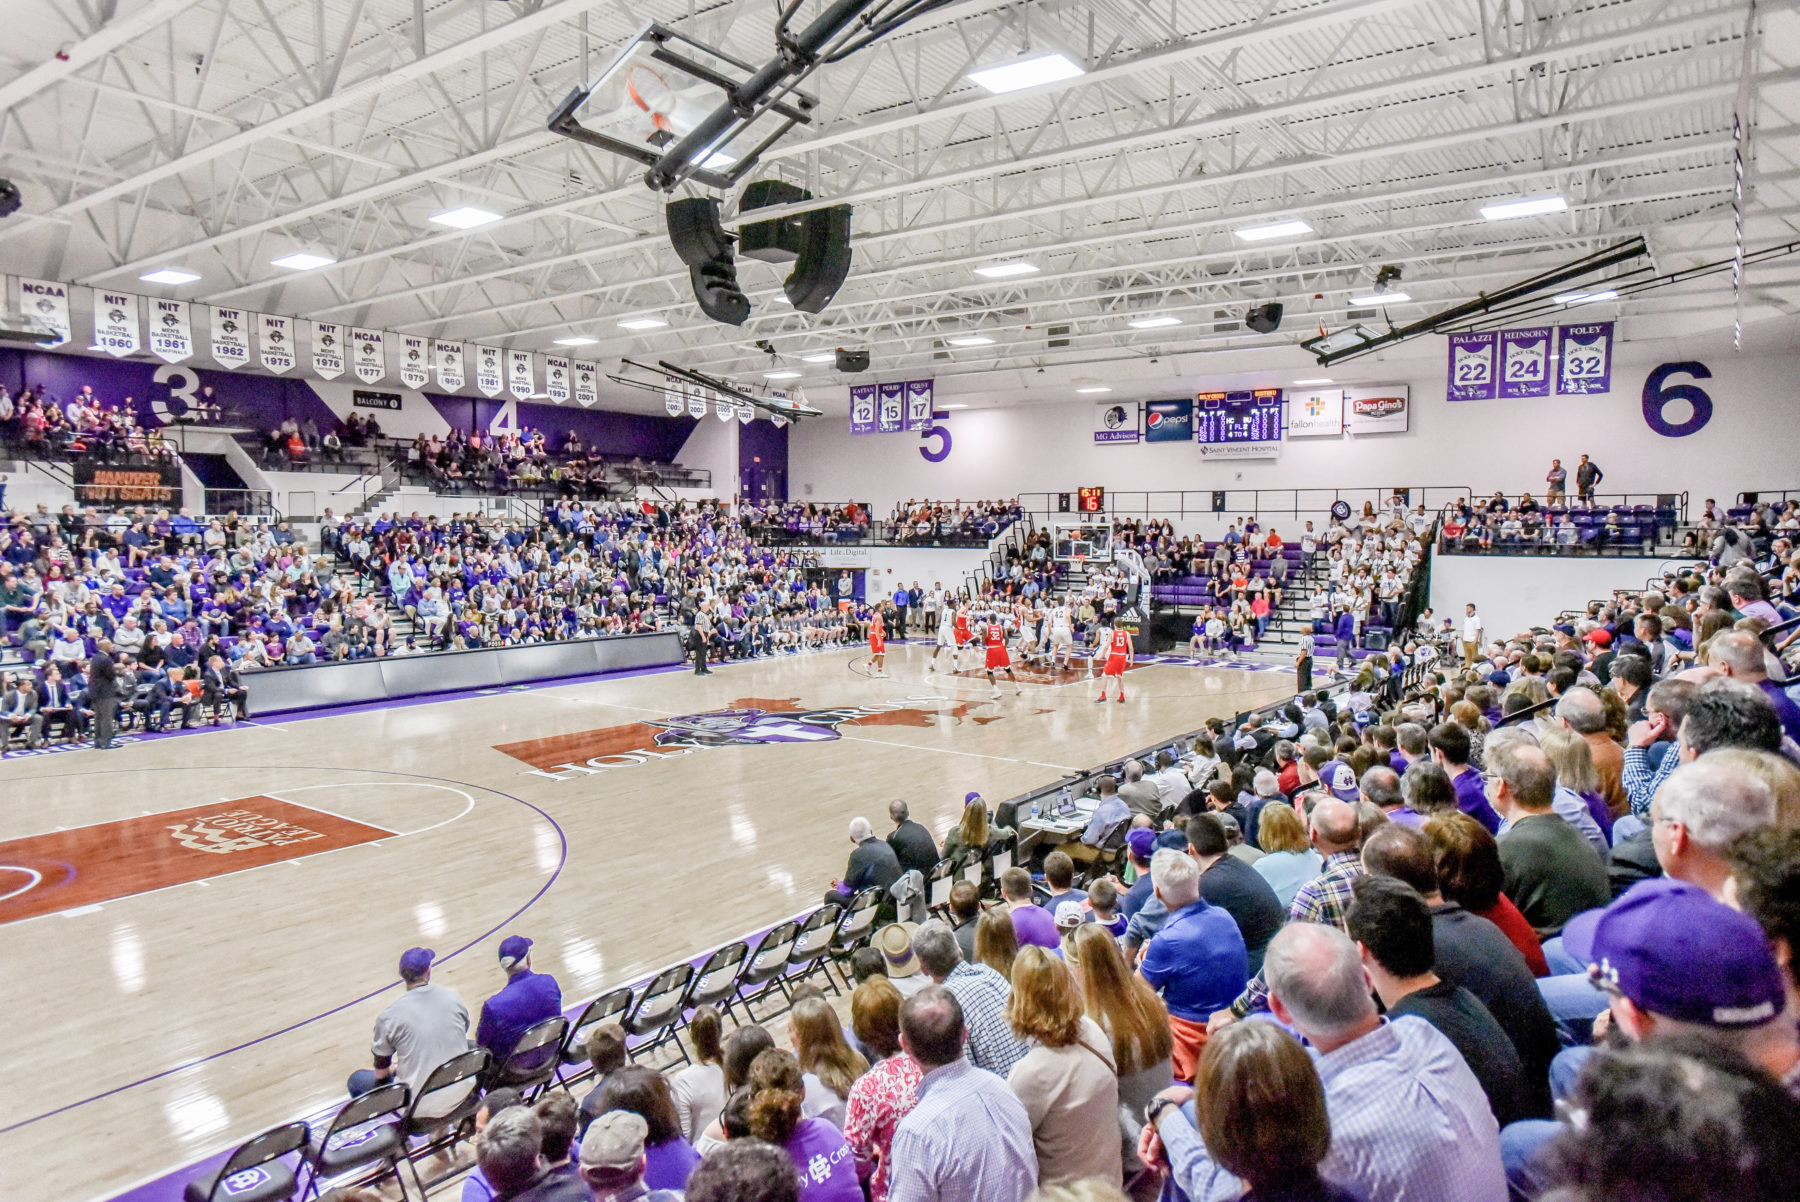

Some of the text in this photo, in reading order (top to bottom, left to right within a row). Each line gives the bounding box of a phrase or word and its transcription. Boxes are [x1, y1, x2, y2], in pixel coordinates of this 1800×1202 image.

[23, 283, 65, 297] NCAA
[104, 294, 128, 306] NIT
[158, 301, 180, 312] NIT
[219, 309, 240, 320] NIT
[266, 318, 285, 328] NIT
[319, 323, 337, 334] NIT
[151, 331, 189, 341] BASKETBALL
[1504, 329, 1549, 340] HEINSOHN
[1569, 325, 1603, 336] FOLEY
[354, 331, 382, 343] NCAA
[1453, 334, 1493, 344] PALAZZI
[101, 337, 133, 349] 1960
[156, 339, 186, 350] 1961
[212, 339, 247, 348] BASKETBALL
[405, 338, 422, 348] NIT
[437, 343, 462, 353] NCAA
[215, 346, 244, 357] 1962
[260, 349, 294, 358] BASKETBALL
[313, 351, 343, 360] BASKETBALL
[482, 347, 497, 357] NIT
[264, 357, 291, 367] 1975
[316, 358, 340, 368] 1976
[514, 353, 528, 362] NIT
[547, 358, 568, 369] NCAA
[575, 363, 595, 373] NCAA
[1510, 359, 1541, 378] 24
[1569, 356, 1601, 376] 32
[359, 368, 381, 377] 1977
[404, 372, 425, 382] 1979
[1459, 363, 1487, 382] 22
[480, 378, 499, 386] 1981
[151, 364, 200, 424] 3
[512, 385, 531, 394] 1990
[548, 389, 567, 398] 1993
[737, 386, 752, 394] NCAA
[772, 390, 786, 398] NCAA
[357, 397, 388, 407] BALCONY
[577, 393, 595, 401] 2001
[1642, 360, 1714, 438] 6
[913, 403, 927, 417] 17
[1355, 400, 1402, 412] Papa Gino's
[857, 407, 871, 421] 12
[884, 405, 899, 419] 15
[489, 398, 522, 438] 4
[1163, 414, 1188, 425] pepsi
[1242, 416, 1253, 424] BU
[919, 410, 953, 463] 5
[1109, 431, 1138, 440] Advisors
[119, 485, 173, 500] SEATS
[1081, 488, 1100, 497] 15:11
[1086, 496, 1097, 510] 16
[1054, 610, 1064, 619] 42
[990, 631, 1000, 641] 32
[1116, 636, 1125, 647] 13
[516, 737, 717, 782] HOLY
[195, 814, 302, 847] PATRIOT
[223, 809, 327, 841] LEAGUE
